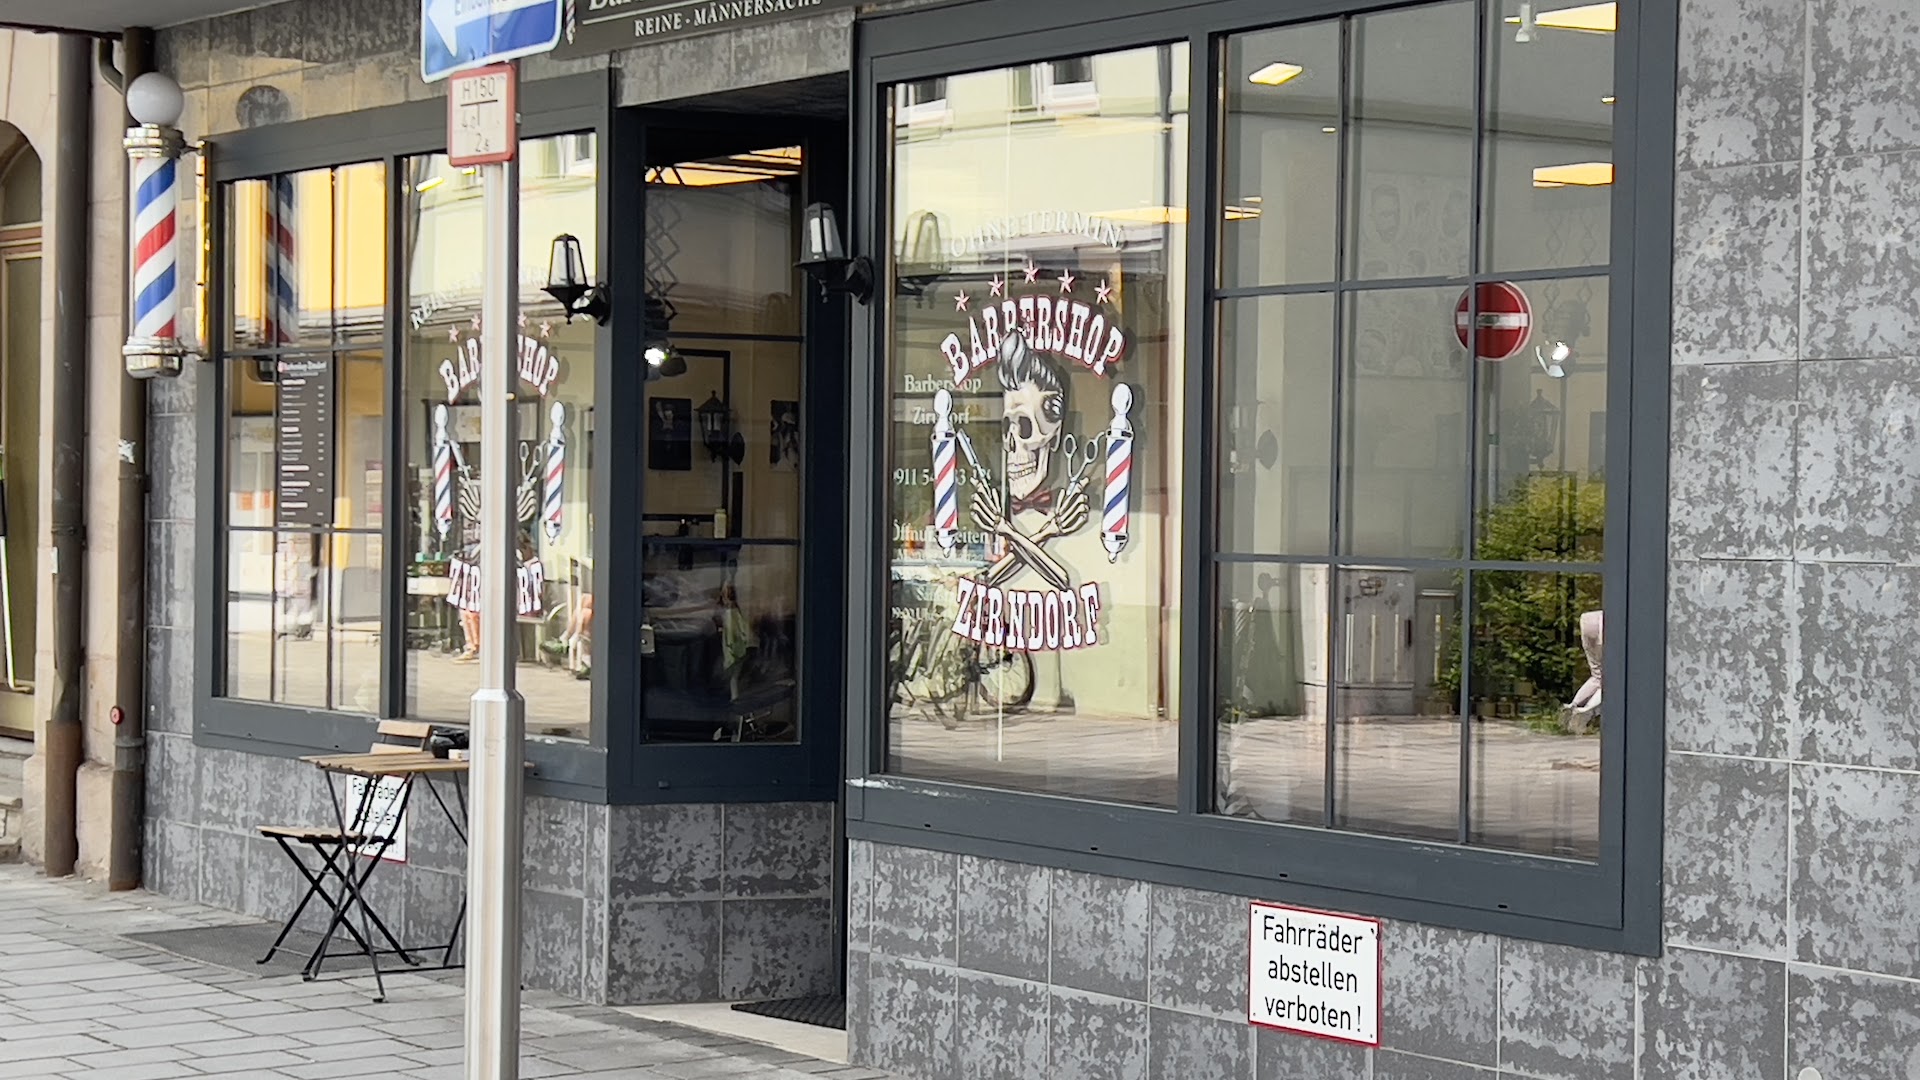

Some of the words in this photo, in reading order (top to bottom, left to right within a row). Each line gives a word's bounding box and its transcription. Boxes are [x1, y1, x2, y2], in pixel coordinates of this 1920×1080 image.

[634, 12, 683, 37] REINE
[1027, 210, 1122, 248] TERMIN
[940, 295, 1125, 386] BARBERSHOP
[904, 374, 981, 394] Barbersop
[951, 577, 1100, 650] ZIRNDORF
[1263, 914, 1364, 955] Fahrräder
[1268, 954, 1358, 994] abstellen
